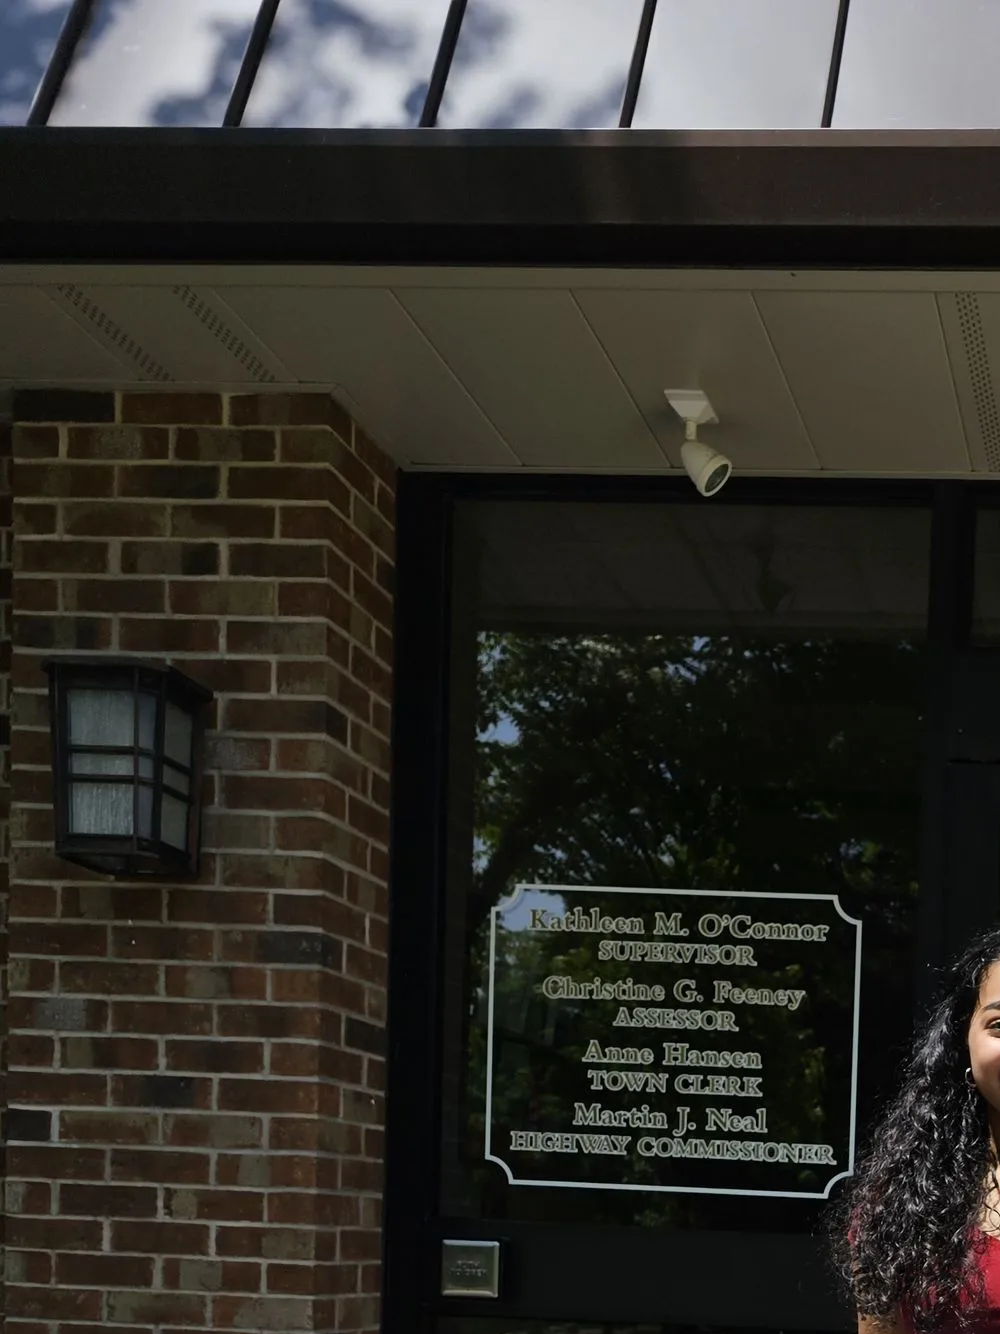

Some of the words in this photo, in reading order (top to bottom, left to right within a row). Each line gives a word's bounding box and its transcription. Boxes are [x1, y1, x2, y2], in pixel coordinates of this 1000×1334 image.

[529, 907, 645, 936] Kathleen
[653, 912, 689, 937] M.
[698, 914, 830, 942] O'Connor
[598, 940, 757, 966] SUPERVISOR
[542, 975, 665, 1002] Christine
[673, 979, 704, 1003] G.
[713, 981, 805, 1010] Feeney
[613, 1007, 739, 1032] ASSESSOR
[582, 1040, 654, 1065] Anne
[662, 1043, 763, 1069] Hansen
[587, 1069, 667, 1093] TOWN
[675, 1074, 763, 1097] CLERK
[572, 1103, 667, 1129] Martin
[673, 1108, 696, 1136] J.
[706, 1107, 767, 1133] Neal
[510, 1131, 631, 1155] HIGHWAY
[637, 1136, 837, 1165] COMMISSIONER
